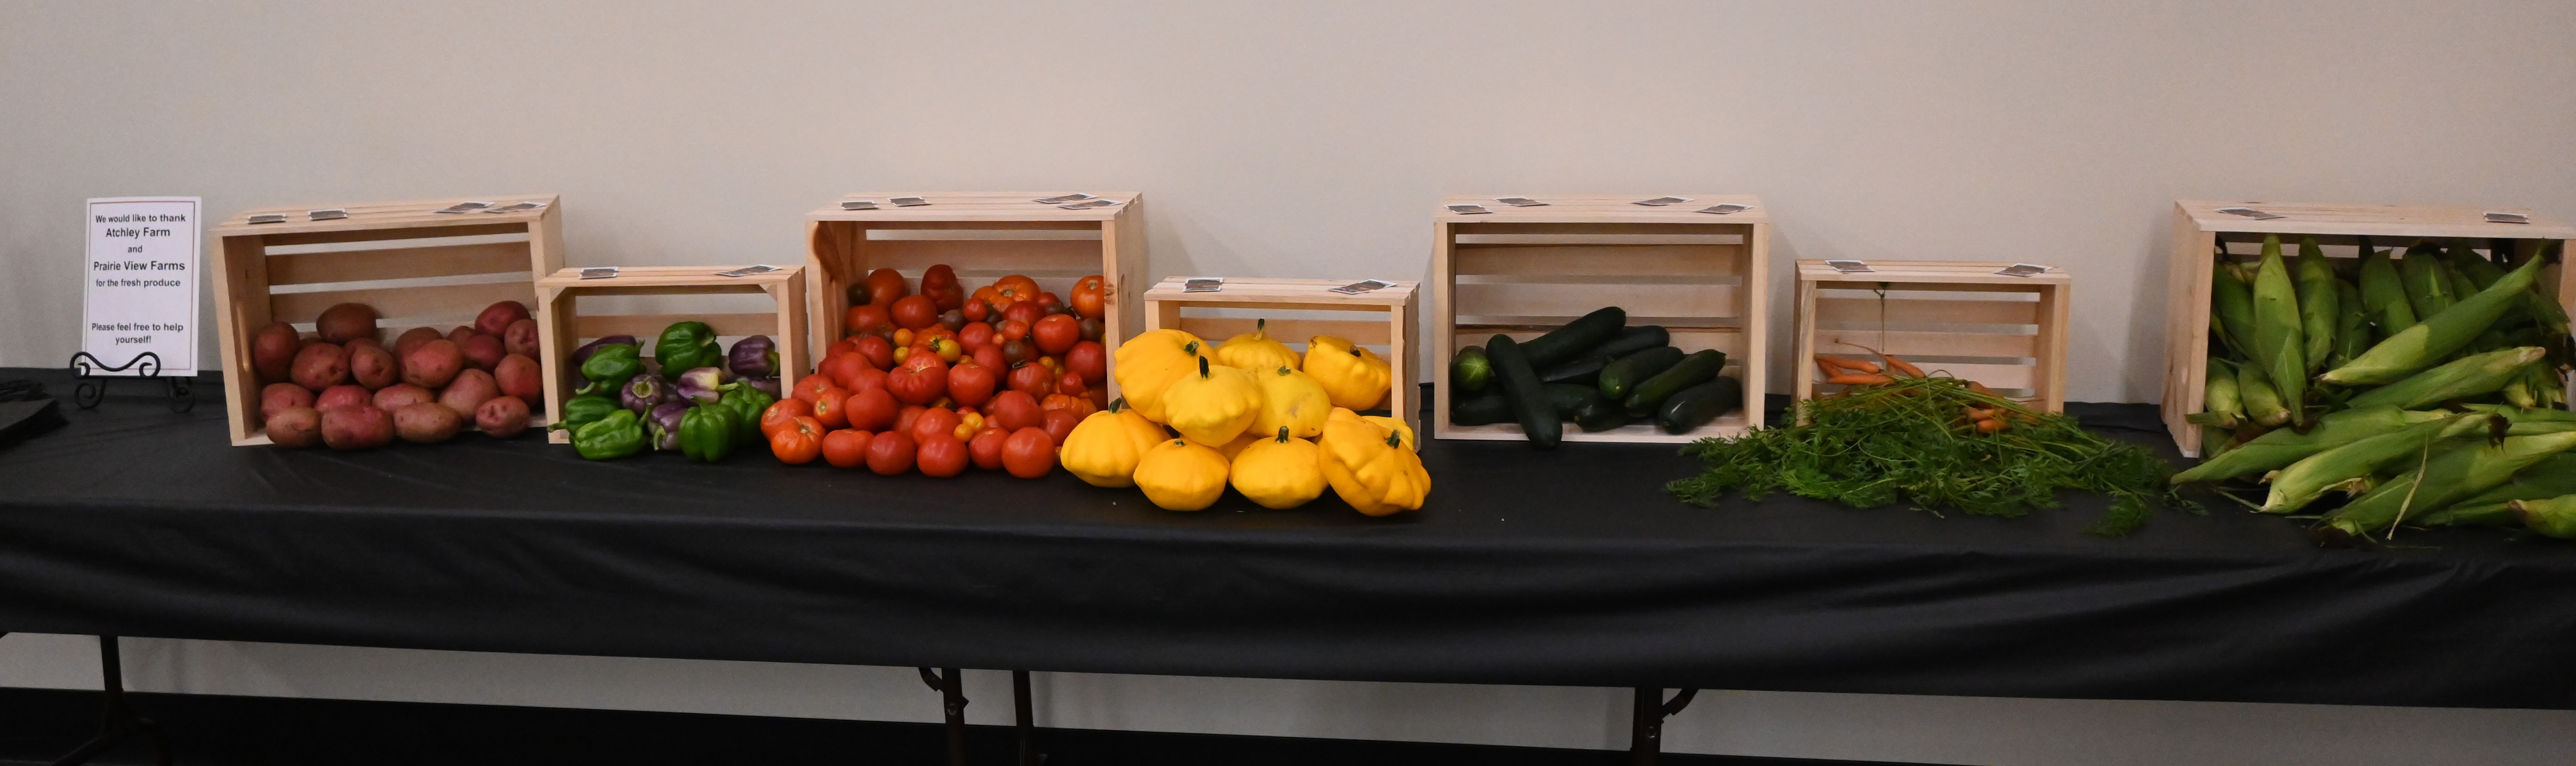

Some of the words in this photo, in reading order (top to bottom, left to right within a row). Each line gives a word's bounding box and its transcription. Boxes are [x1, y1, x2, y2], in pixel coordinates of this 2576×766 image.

[95, 215, 106, 223] We
[108, 214, 130, 223] would
[132, 213, 147, 222] like
[149, 214, 157, 222] to
[160, 213, 186, 222] thank
[105, 227, 140, 240] Atchley
[143, 227, 170, 237] Farm
[127, 245, 143, 253] and
[93, 260, 121, 271] Prairie
[124, 260, 148, 271] View
[150, 260, 186, 271] Farms
[96, 278, 105, 287] for
[107, 278, 119, 287] the
[120, 278, 141, 287] fresh
[143, 278, 181, 289] produce
[92, 322, 115, 331] Please
[117, 322, 131, 331] feel
[133, 322, 150, 331] free
[163, 322, 184, 334] help
[115, 335, 152, 346] yourself!
